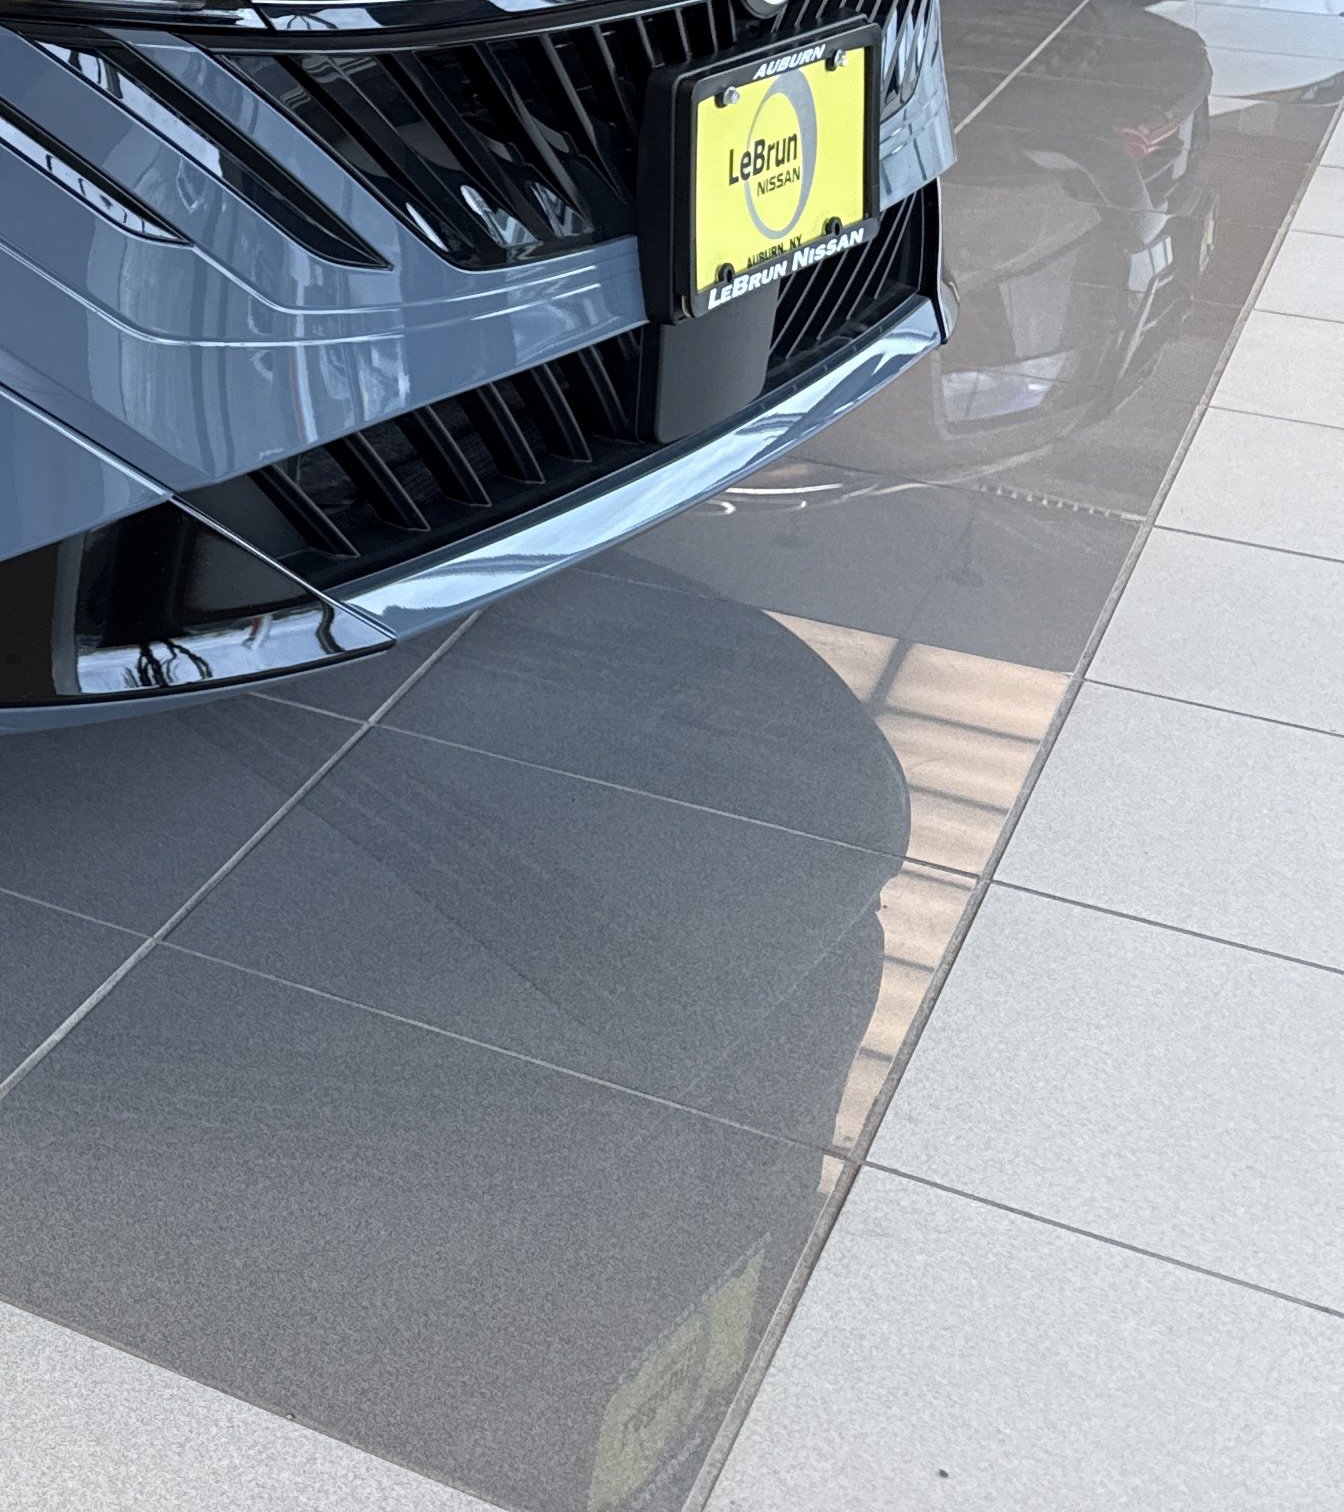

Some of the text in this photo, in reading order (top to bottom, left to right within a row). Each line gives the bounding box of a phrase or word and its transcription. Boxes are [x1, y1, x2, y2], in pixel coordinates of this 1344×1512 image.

[752, 44, 826, 81] AUBURN
[728, 132, 798, 186] LeBrun
[756, 165, 801, 197] NISSAN
[789, 234, 803, 252] NY
[792, 228, 864, 271] NISSAN
